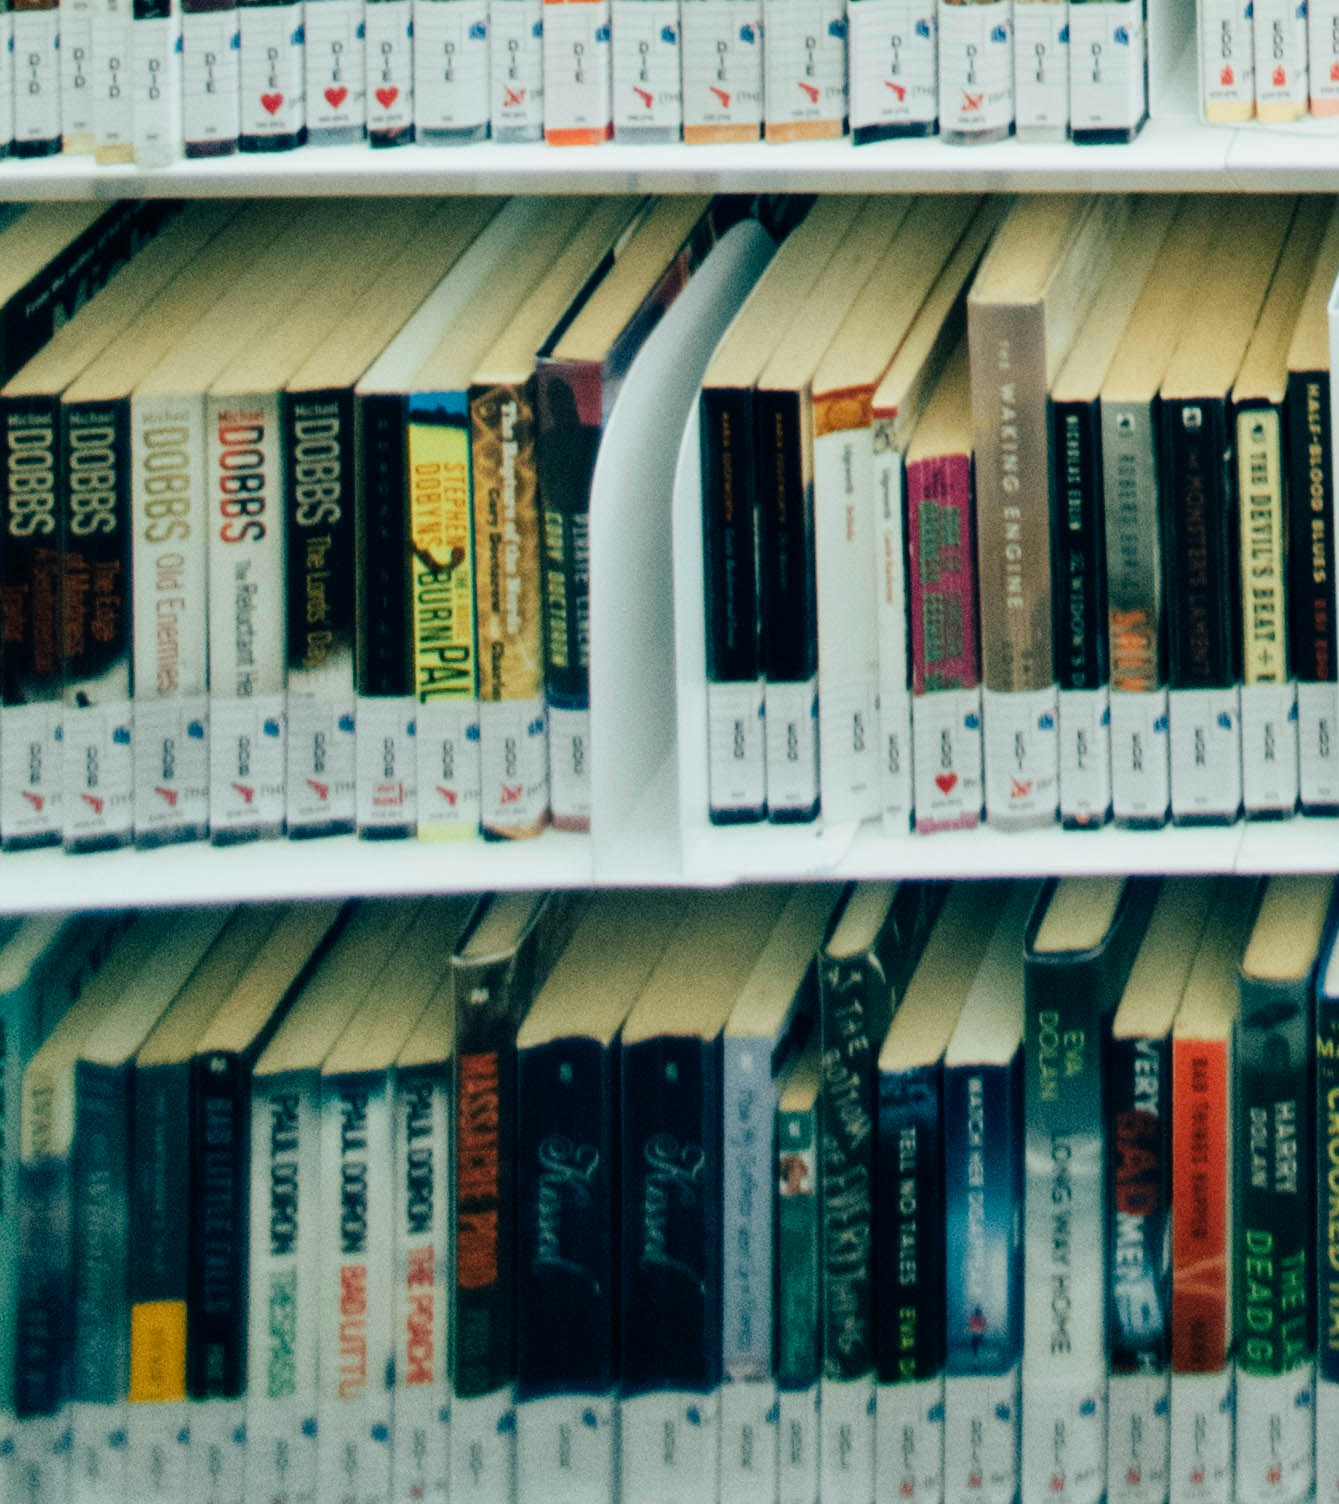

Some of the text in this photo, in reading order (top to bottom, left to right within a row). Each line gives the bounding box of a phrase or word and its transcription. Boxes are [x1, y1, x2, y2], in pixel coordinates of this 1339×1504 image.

[143, 425, 191, 593] DOBBS Old
[218, 422, 267, 543] DOBBS
[1000, 379, 1023, 611] WAKING ENGINE
